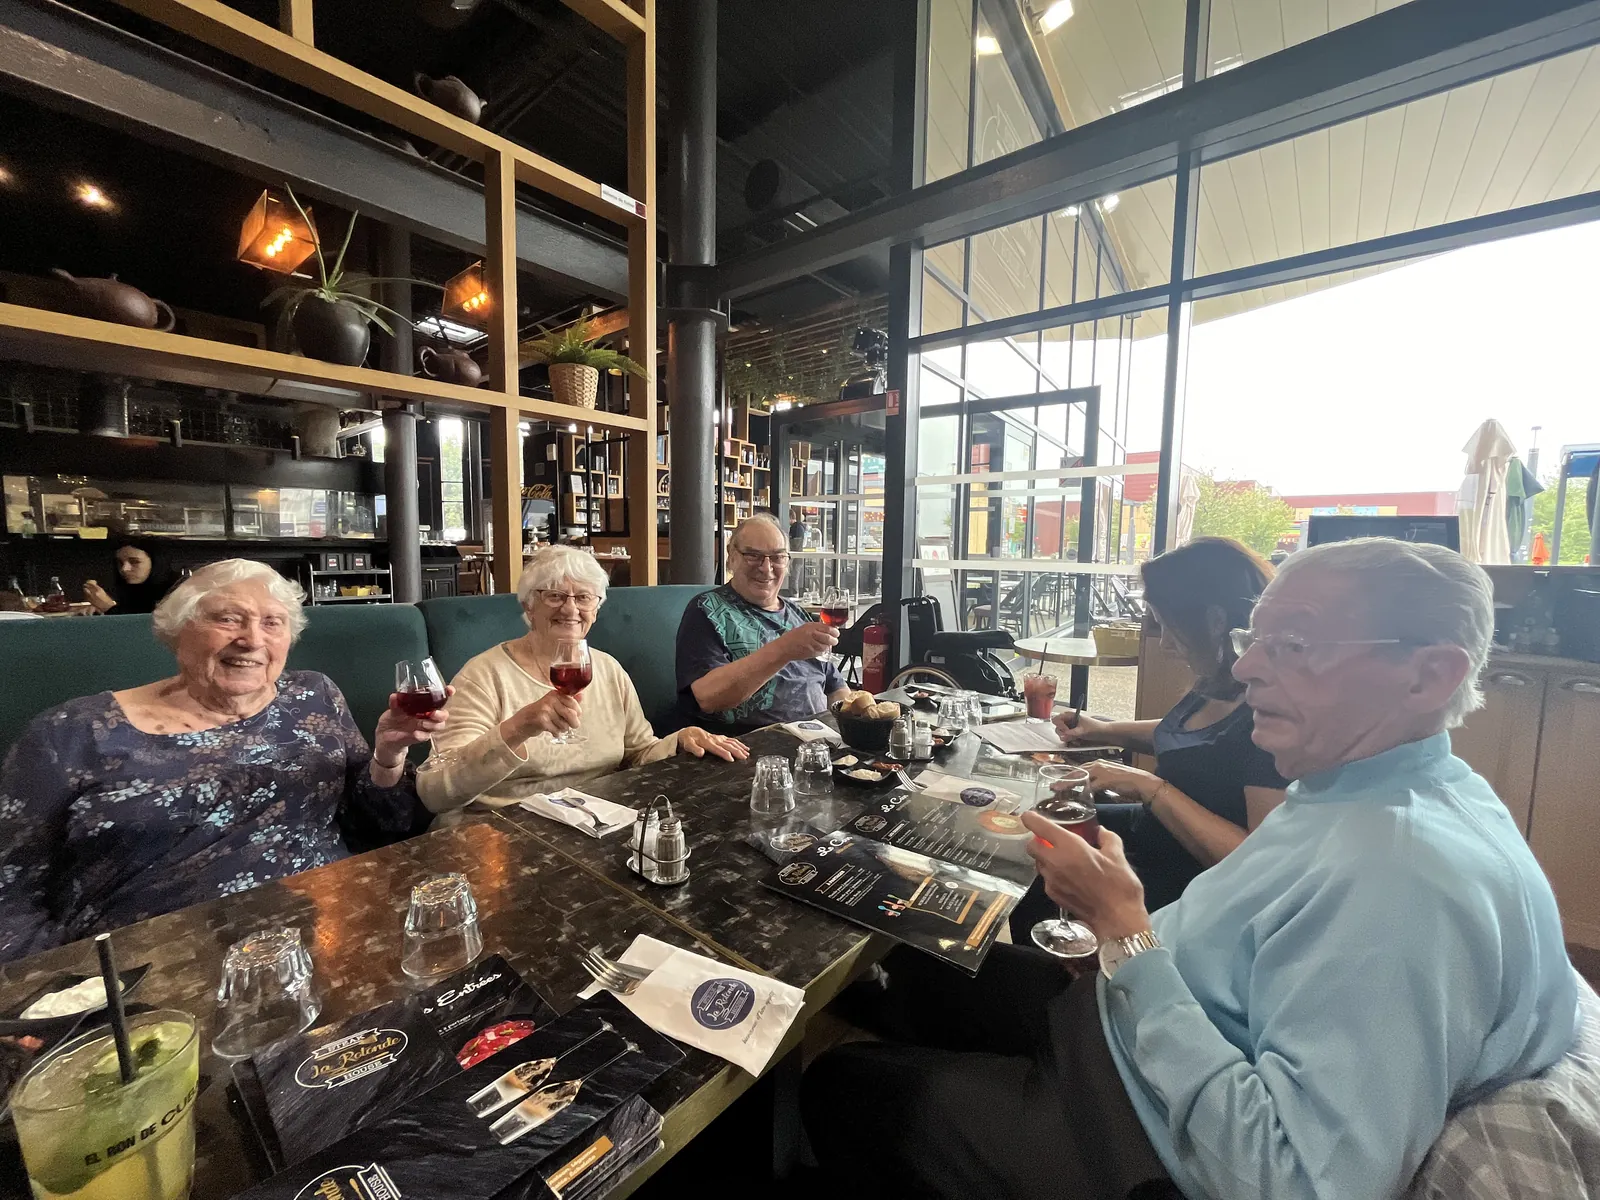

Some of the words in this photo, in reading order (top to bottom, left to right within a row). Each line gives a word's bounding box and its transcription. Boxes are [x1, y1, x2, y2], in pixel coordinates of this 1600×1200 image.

[436, 973, 502, 1007] Entrées
[338, 1037, 401, 1071] Rotonde
[343, 1060, 383, 1081] HOUSE
[141, 1122, 157, 1141] DE
[161, 1083, 198, 1125] CUB
